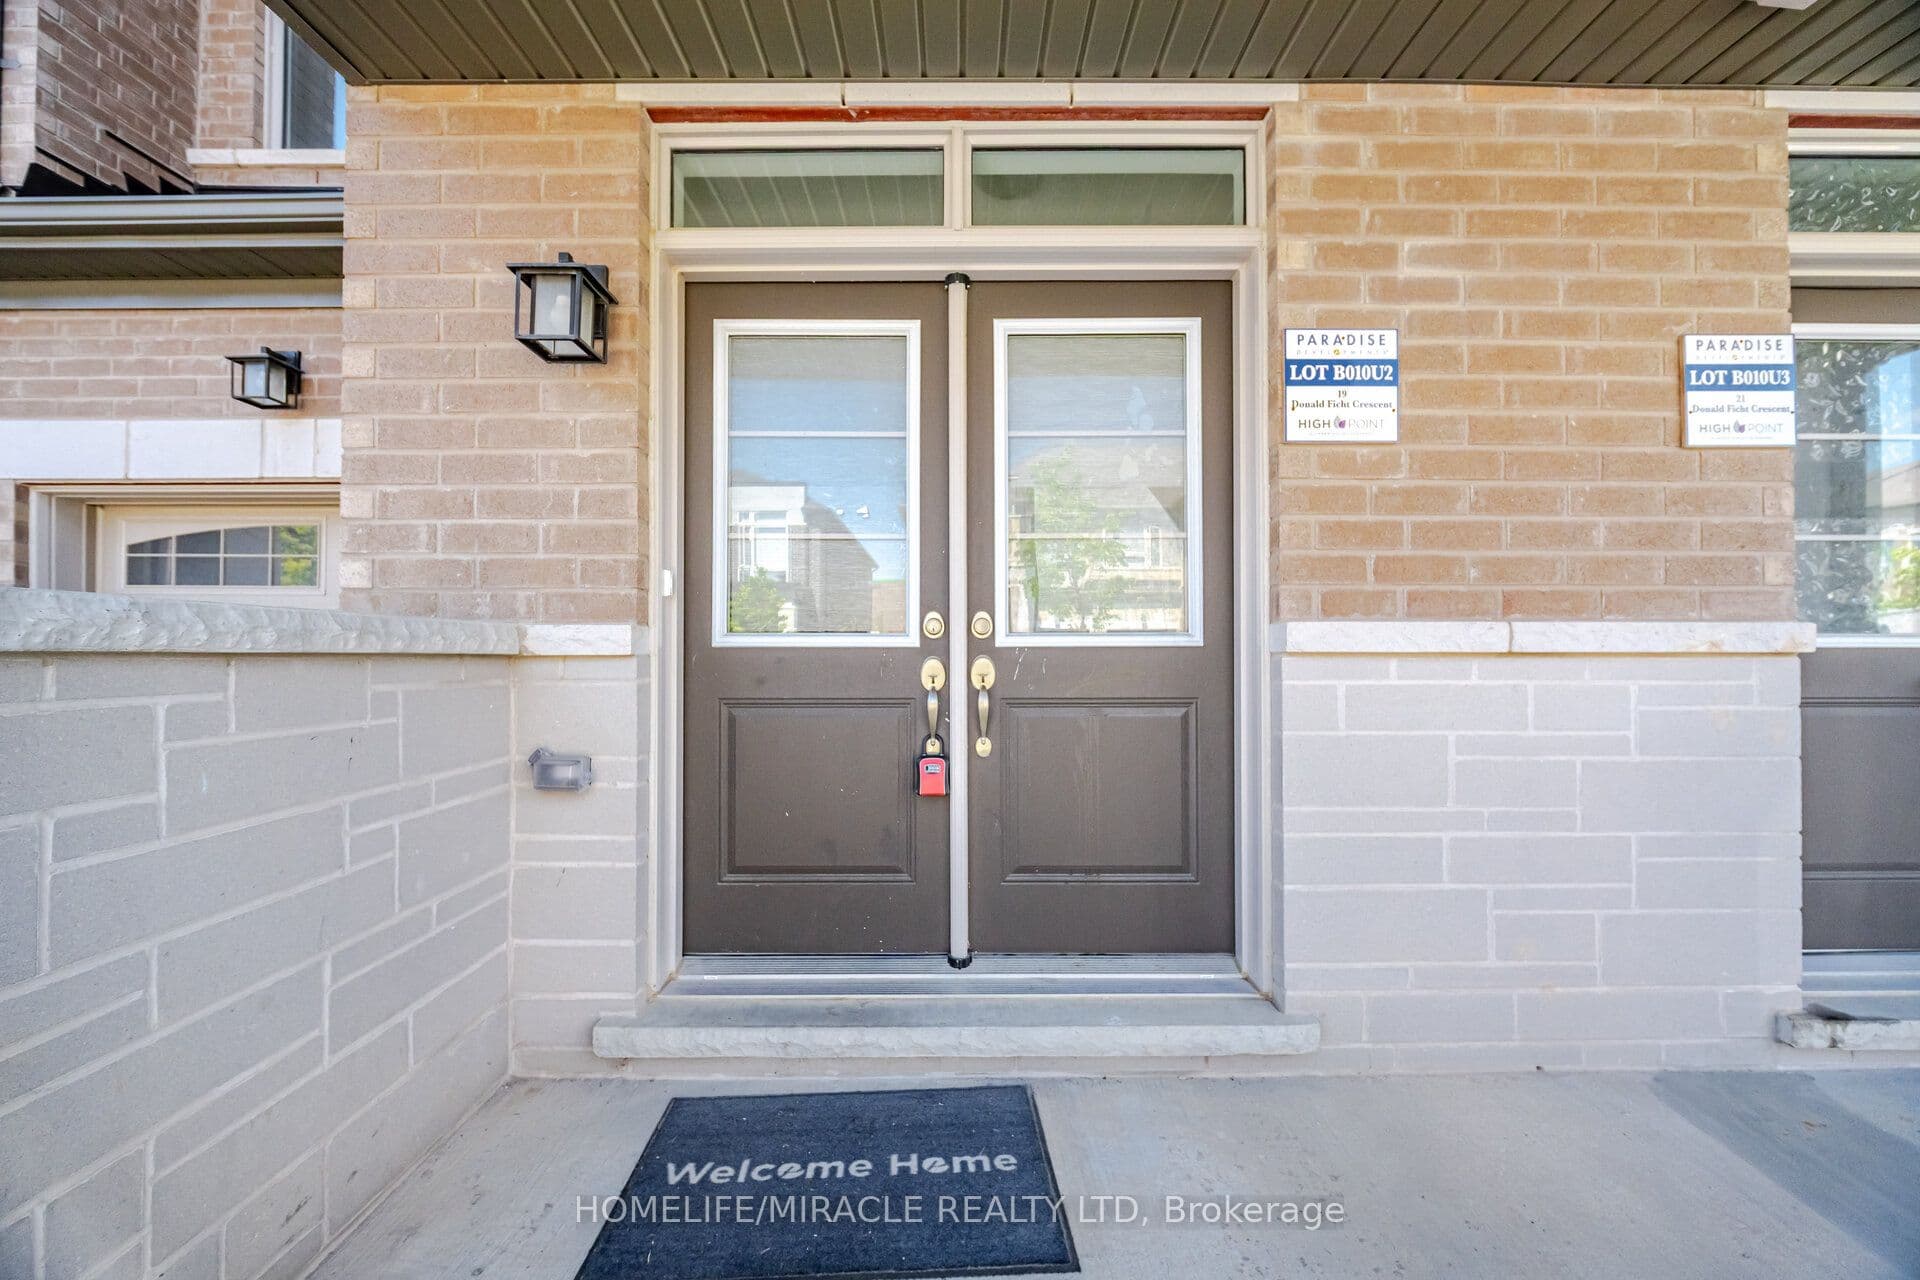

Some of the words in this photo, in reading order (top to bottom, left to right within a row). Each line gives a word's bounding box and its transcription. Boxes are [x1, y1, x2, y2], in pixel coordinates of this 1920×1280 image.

[1297, 334, 1386, 346] PARADISE
[1696, 339, 1782, 351] PARADISE
[1290, 365, 1329, 380] LOT
[1333, 365, 1394, 380] B010U2
[1690, 370, 1728, 385] LOT
[1732, 370, 1791, 385] B010U3
[1337, 390, 1347, 398] 19
[1291, 400, 1325, 409] Donald
[1327, 400, 1350, 408] Ficht
[1352, 400, 1393, 408] Crescent
[1692, 404, 1725, 413] Donald
[1751, 404, 1790, 413] Crescent
[1298, 419, 1331, 429] HIGH
[1348, 418, 1384, 429] POINT
[1699, 423, 1731, 433] HIGH
[1747, 422, 1784, 433] POINT
[666, 1157, 873, 1185] Welcome
[889, 1153, 1018, 1175] Home
